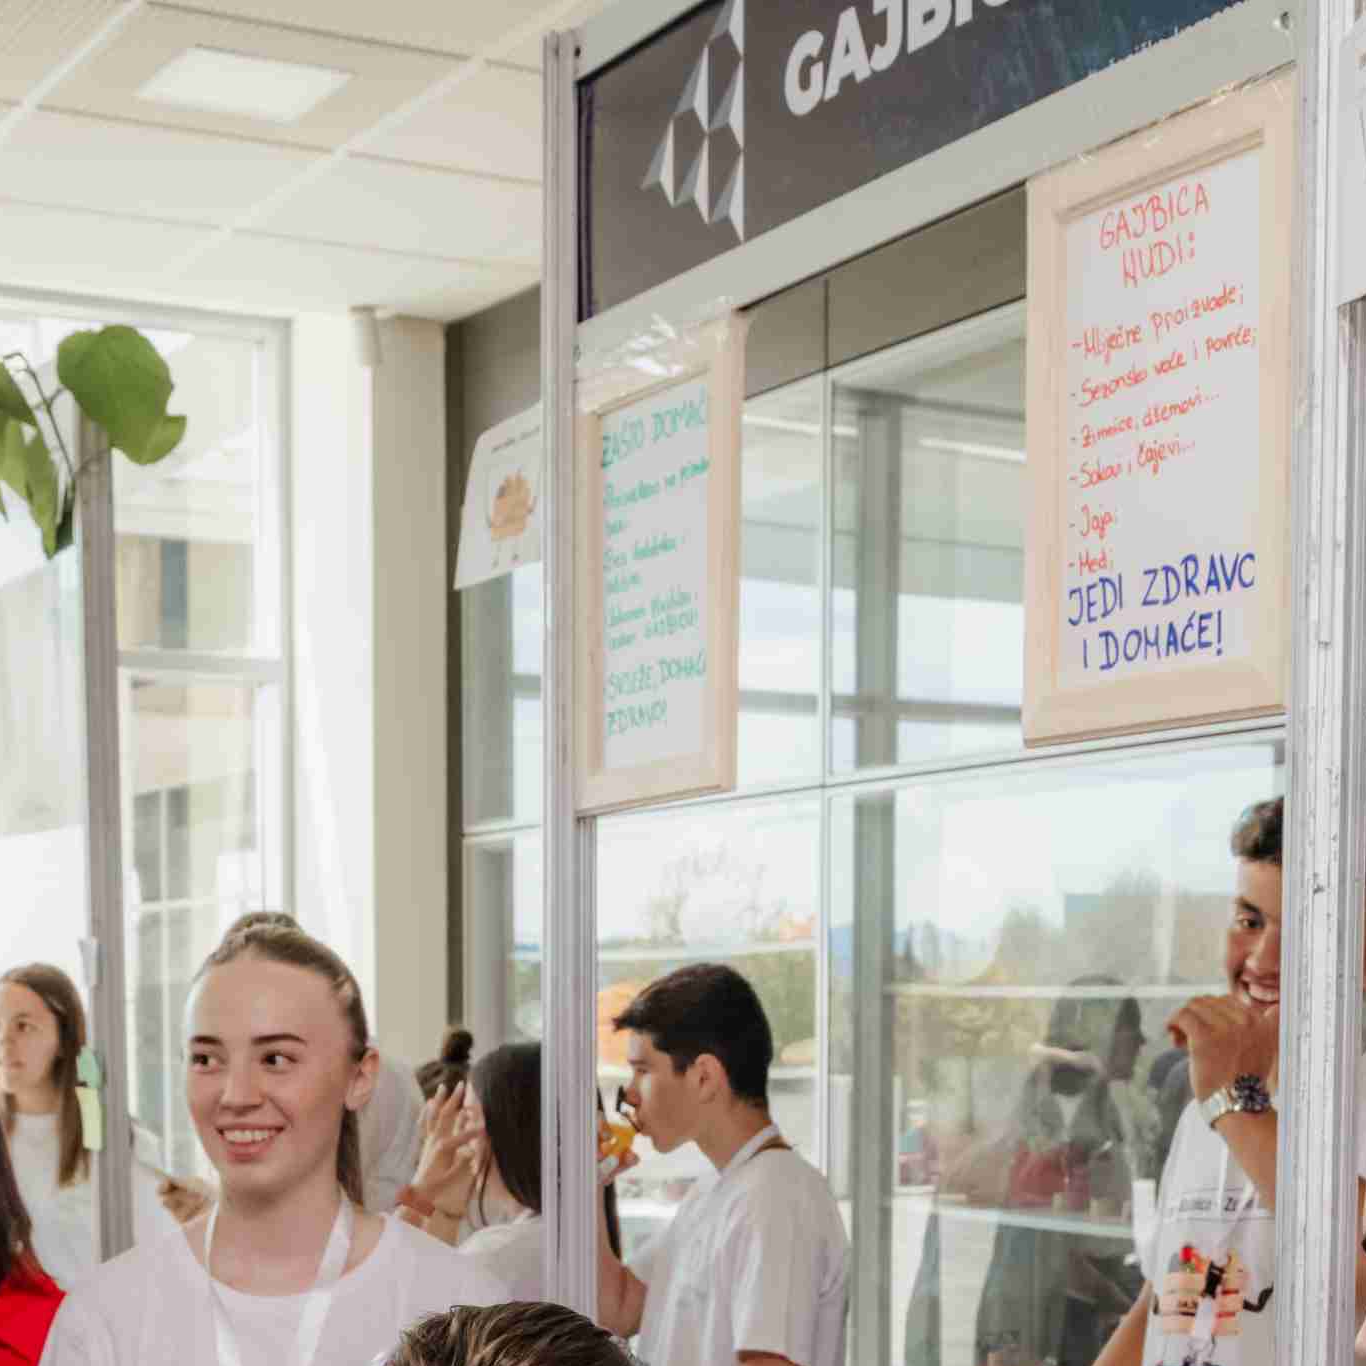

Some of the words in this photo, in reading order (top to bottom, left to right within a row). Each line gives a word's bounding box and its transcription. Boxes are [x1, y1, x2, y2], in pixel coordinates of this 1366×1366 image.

[1100, 183, 1209, 250] GAJBICA
[1068, 572, 1123, 626] JEDI
[1099, 609, 1223, 671] DOMAĆE!
